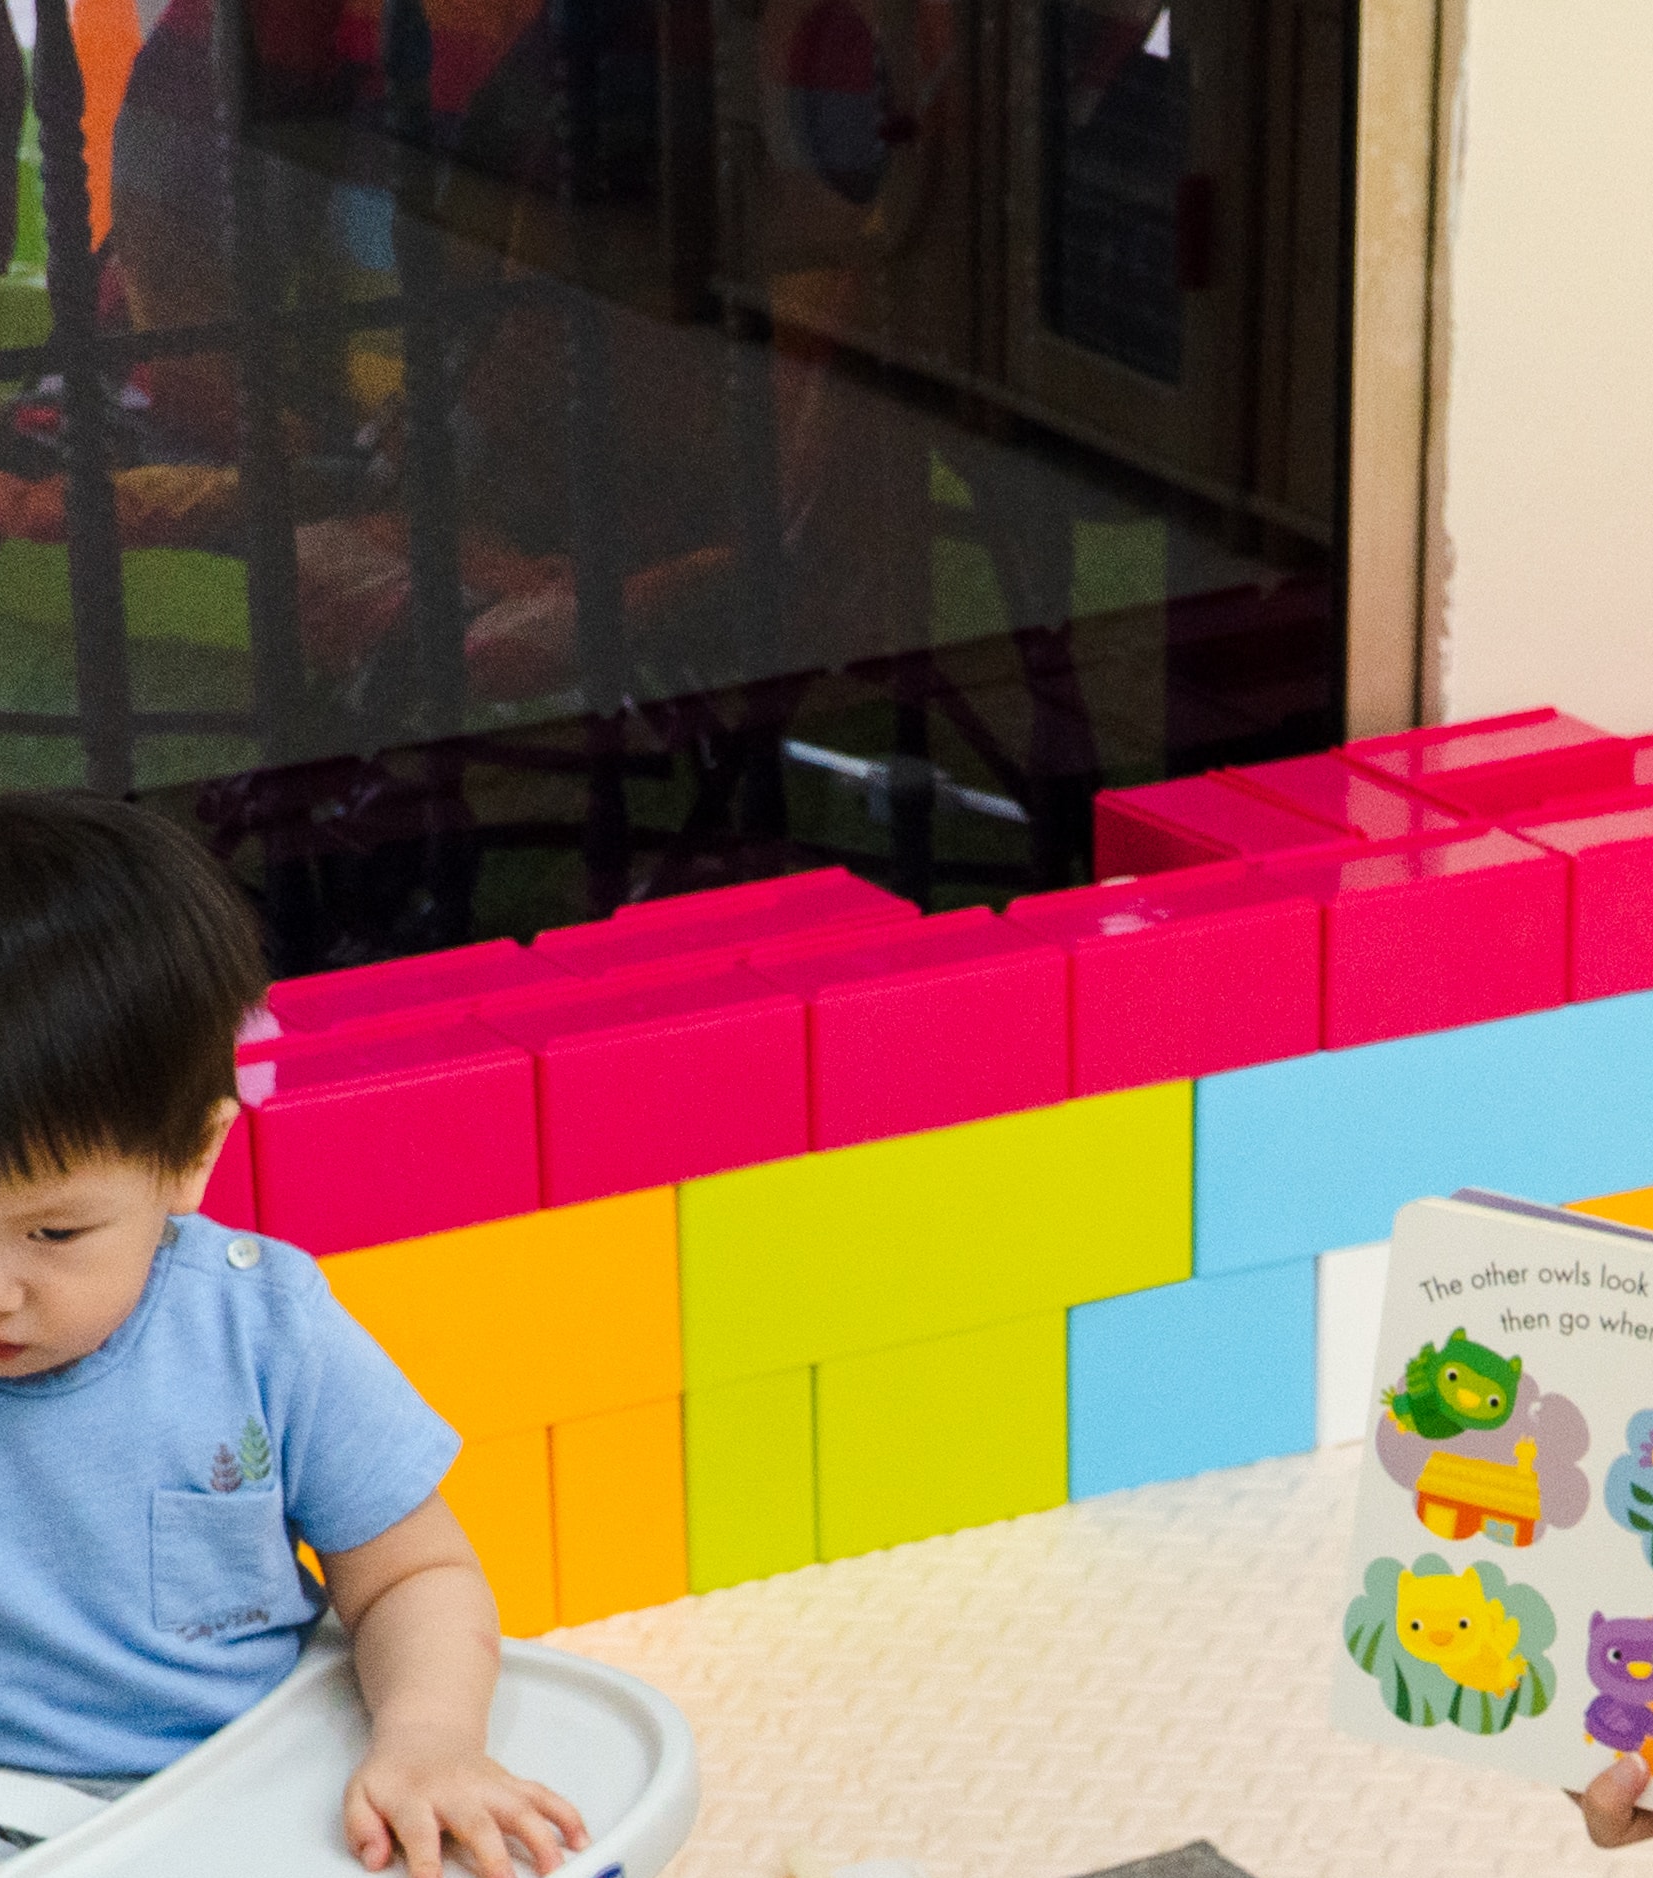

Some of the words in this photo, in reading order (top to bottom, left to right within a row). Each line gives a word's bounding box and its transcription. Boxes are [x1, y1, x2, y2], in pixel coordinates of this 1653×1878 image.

[1420, 1276, 1463, 1303] The
[1471, 1261, 1528, 1290] other
[1538, 1260, 1592, 1287] owls
[1600, 1265, 1649, 1298] look
[1500, 1308, 1550, 1334] then
[1559, 1312, 1590, 1337] go
